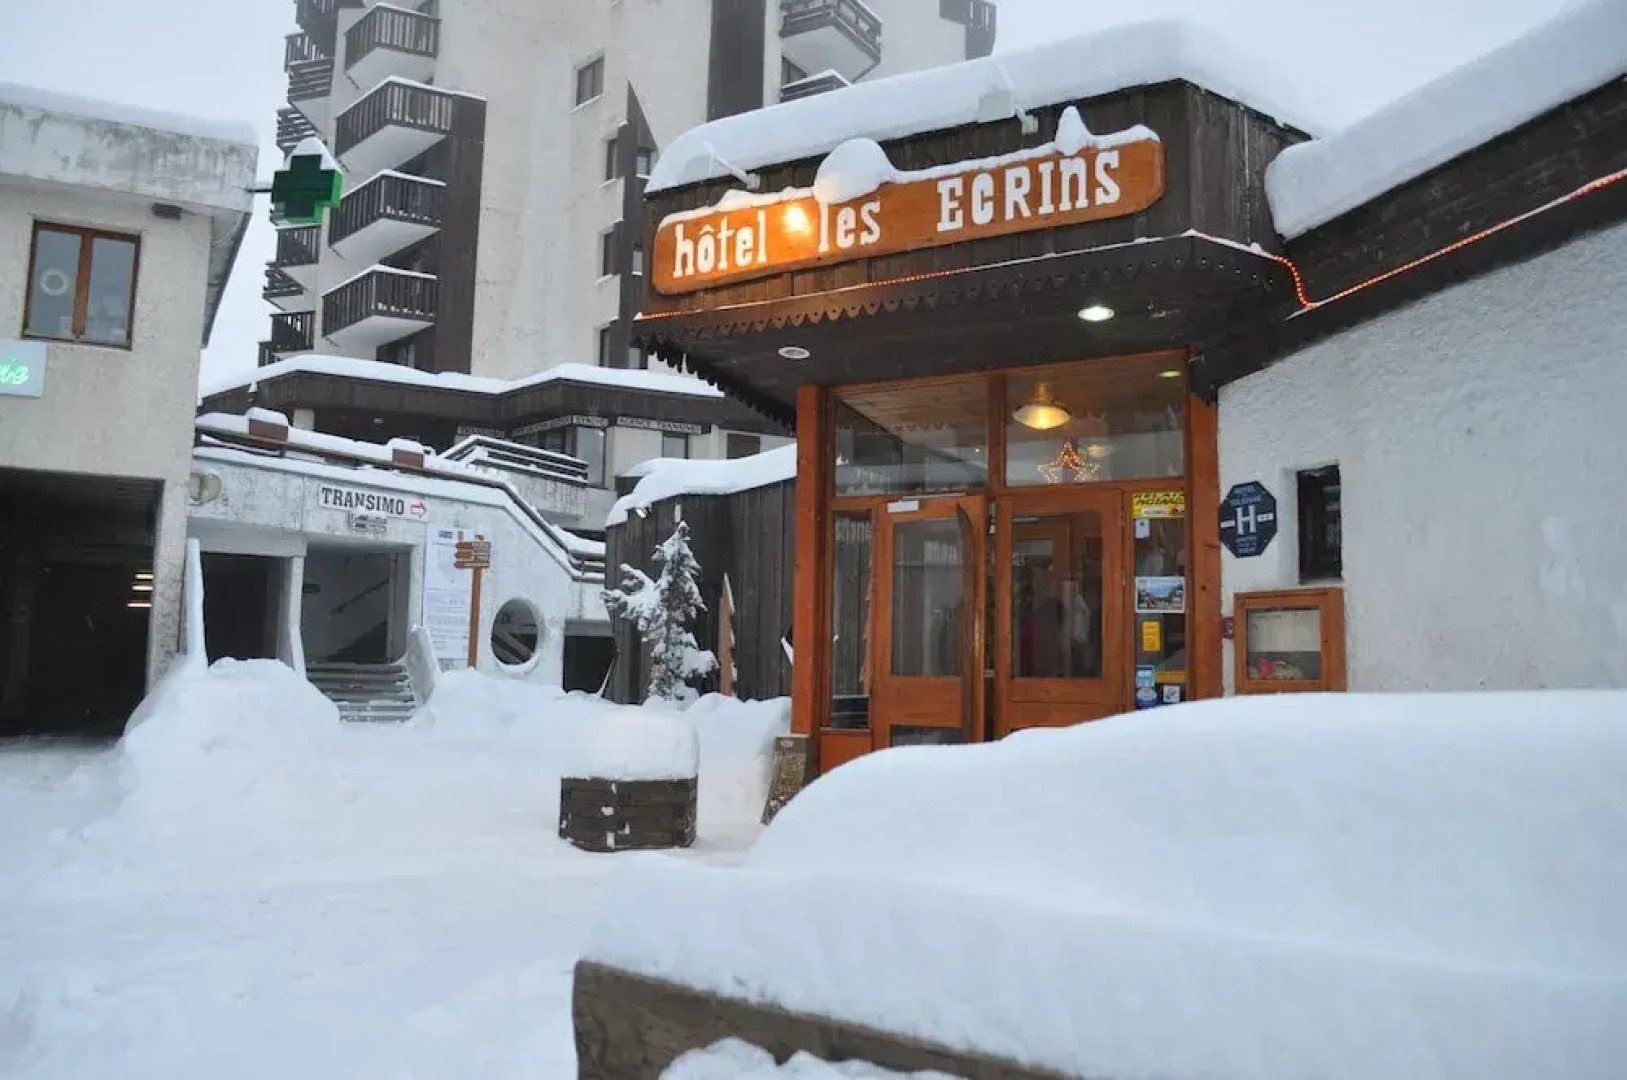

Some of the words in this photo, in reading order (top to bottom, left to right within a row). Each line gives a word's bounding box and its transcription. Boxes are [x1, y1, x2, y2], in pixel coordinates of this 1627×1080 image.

[673, 209, 767, 278] hôtel
[818, 200, 881, 253] les
[321, 487, 405, 515] TRANSIMO
[1236, 505, 1257, 535] H
